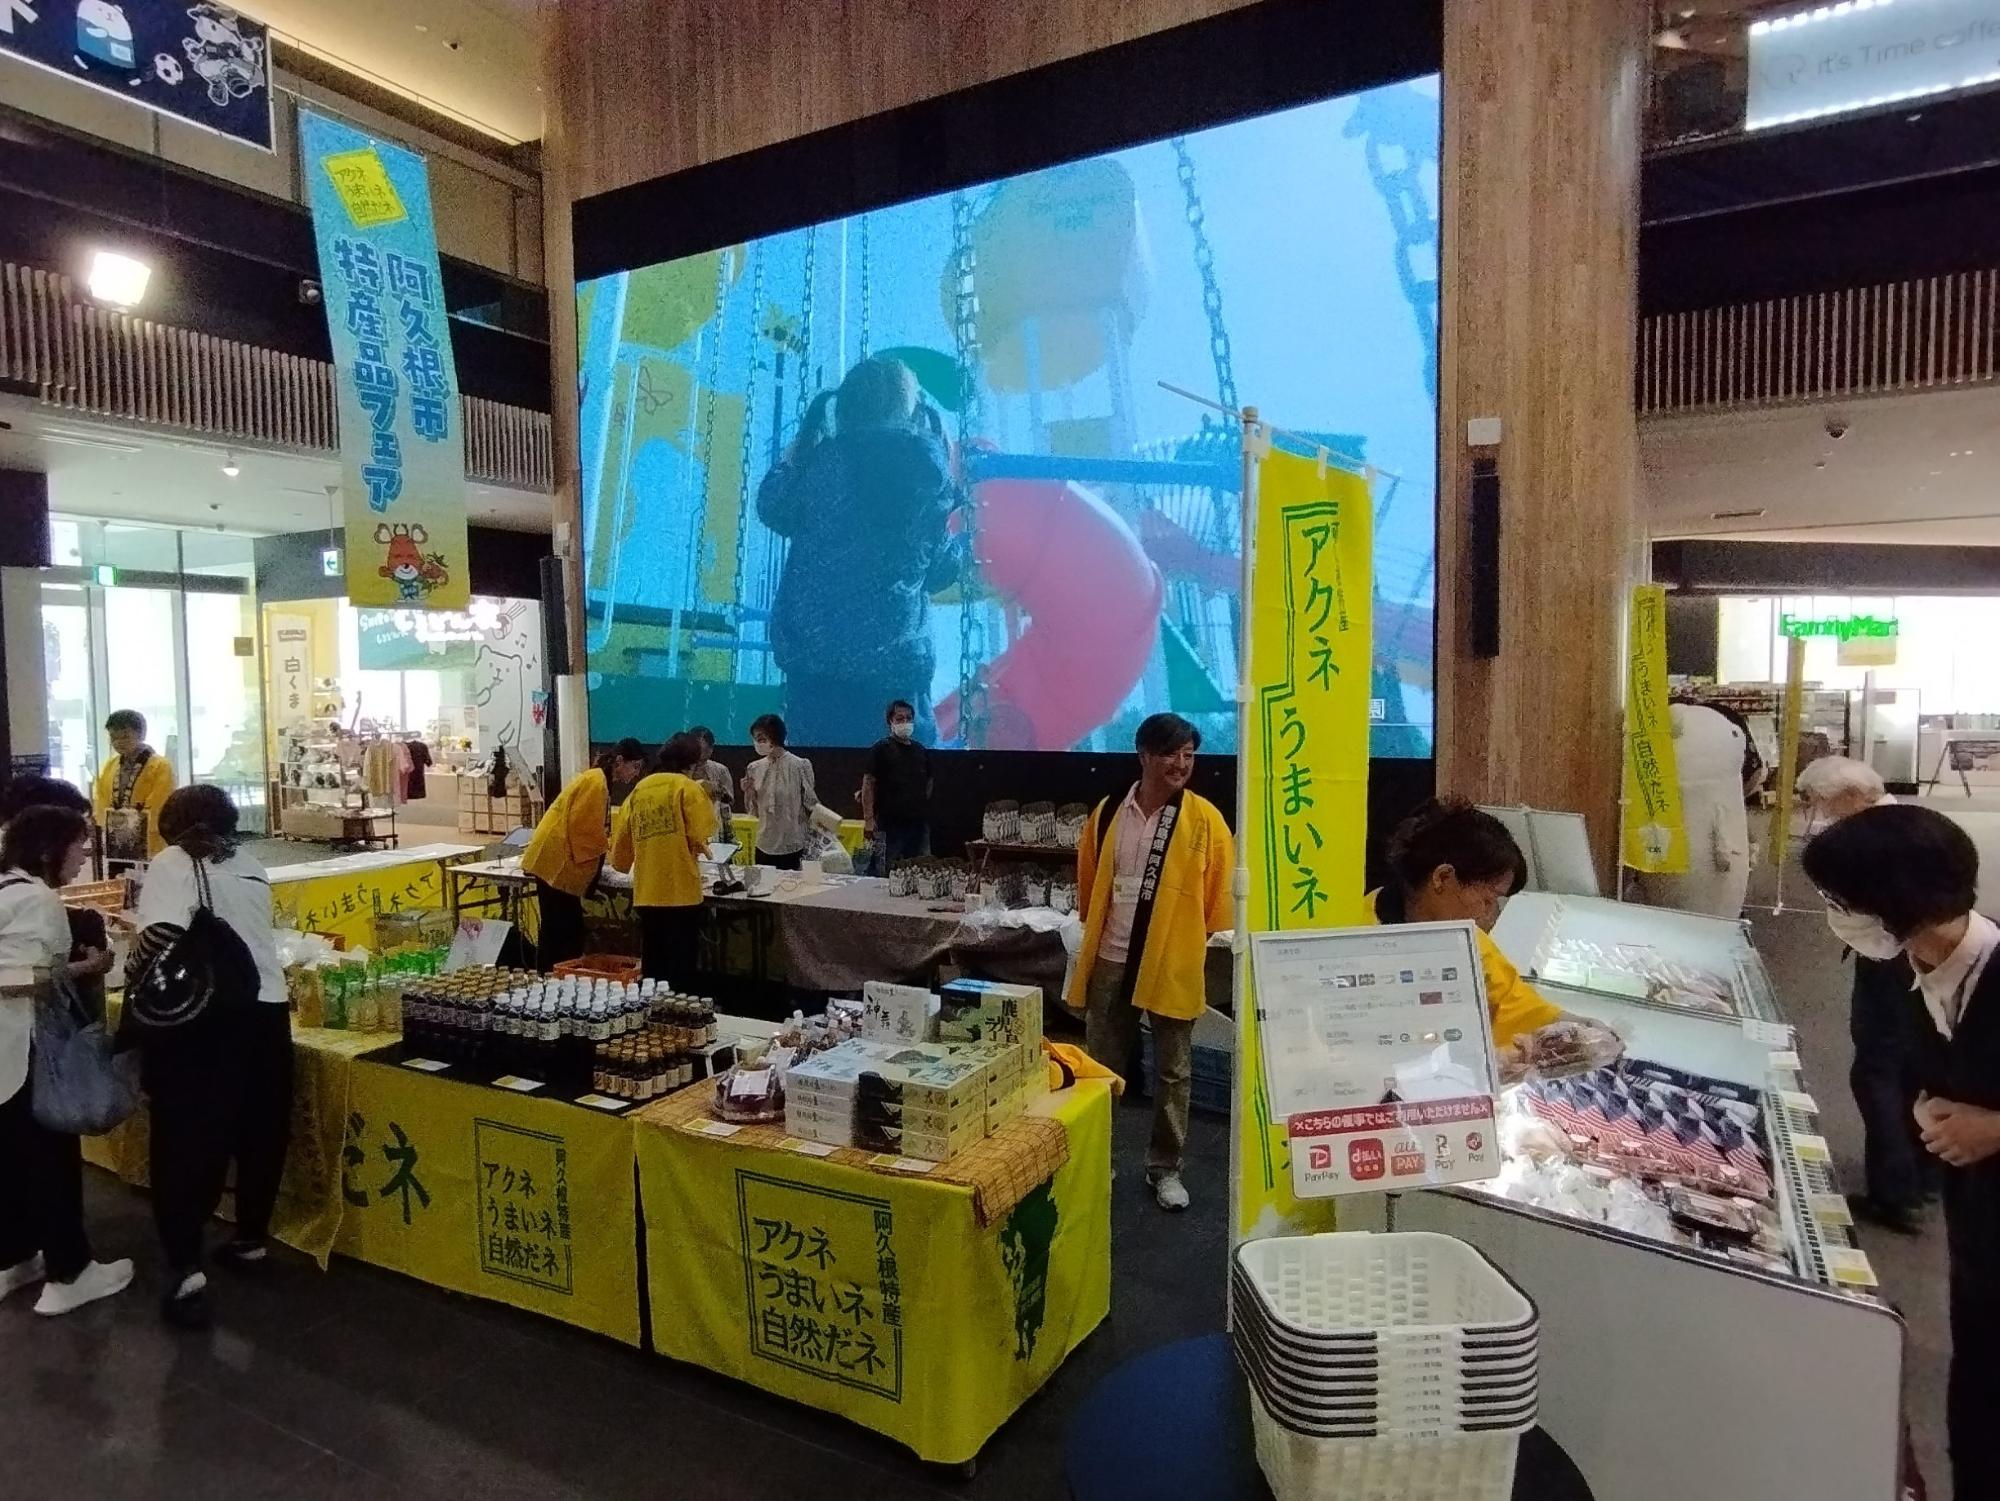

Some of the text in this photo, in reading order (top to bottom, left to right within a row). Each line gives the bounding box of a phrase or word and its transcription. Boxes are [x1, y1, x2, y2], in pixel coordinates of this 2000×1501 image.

[1858, 38, 1926, 63] Time
[333, 238, 403, 513] 特産品フェア
[386, 251, 450, 442] 阿久根市
[1301, 524, 1340, 692] アクネ
[284, 655, 301, 710] 白くま
[1279, 706, 1329, 921] うまいネ
[483, 1161, 537, 1199] アクネ
[487, 1198, 558, 1240] うまいネ
[752, 1216, 836, 1270] アクネ
[488, 1232, 559, 1277] 自然だネ
[873, 1210, 903, 1327] 阿久根特産
[759, 1261, 874, 1326] うまいネ
[762, 1307, 886, 1376] 自然だネ
